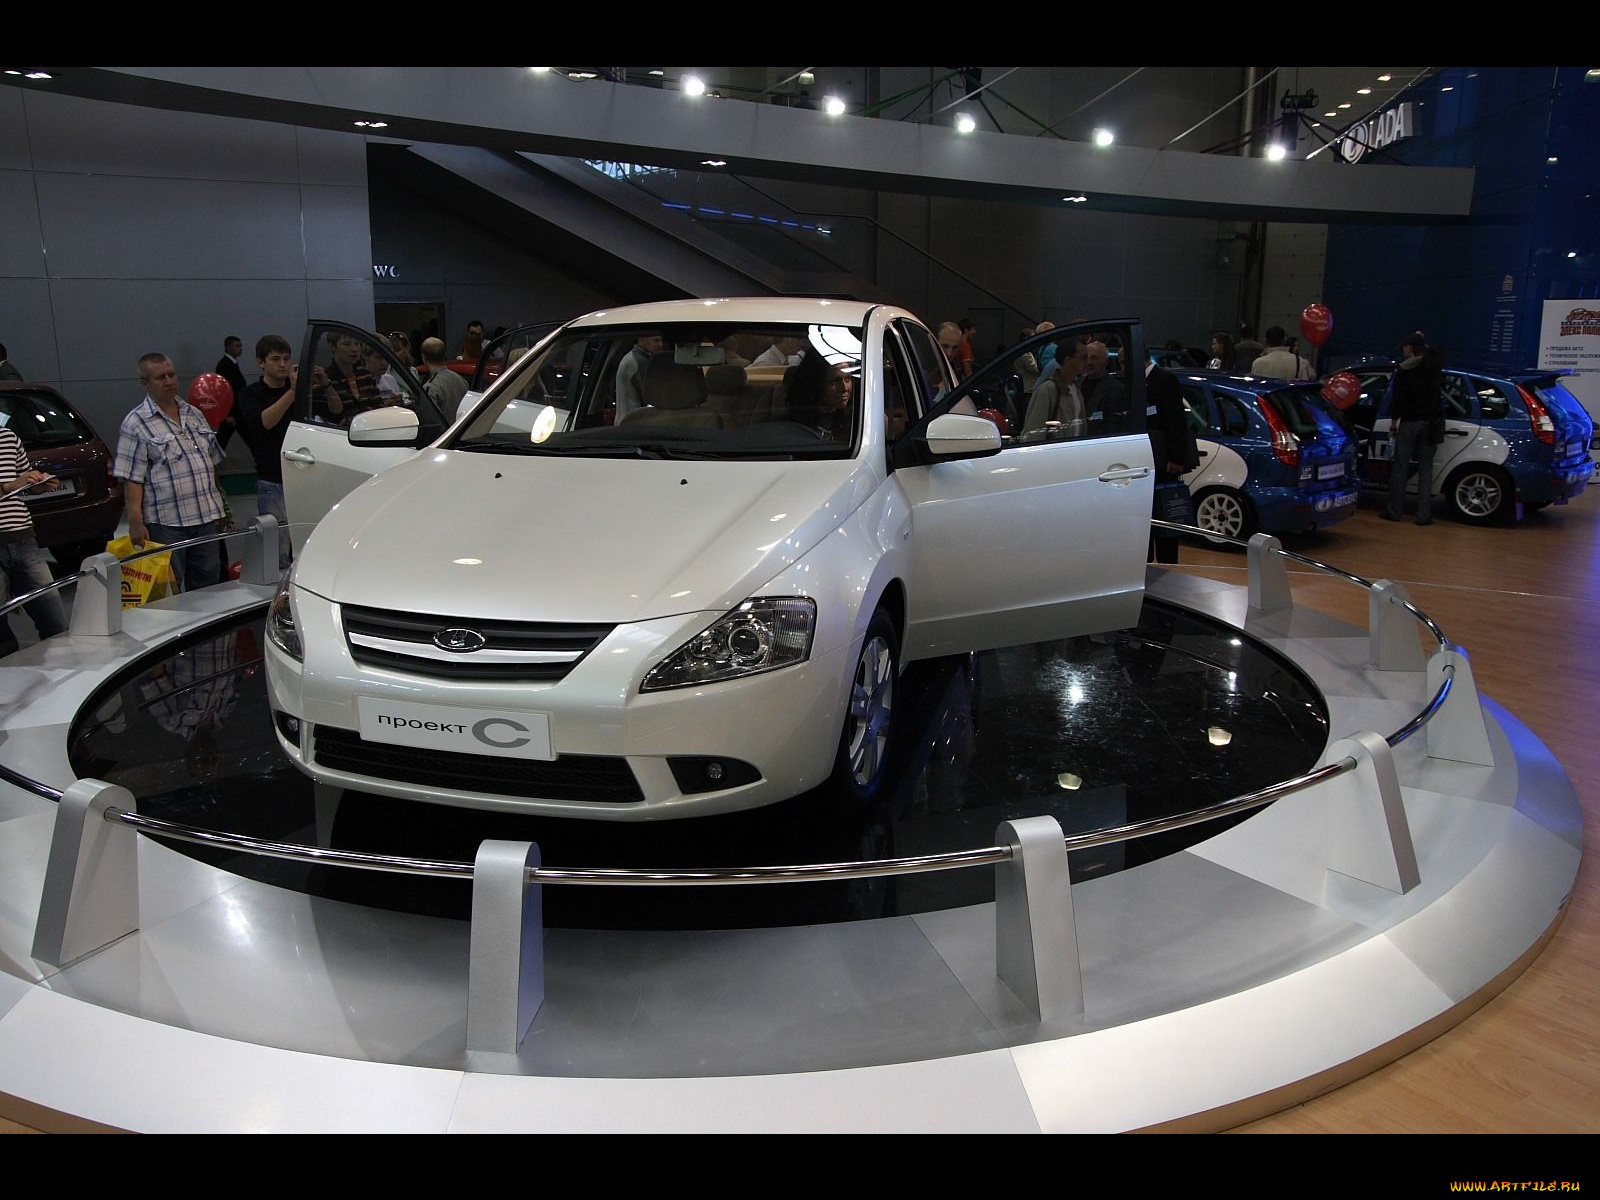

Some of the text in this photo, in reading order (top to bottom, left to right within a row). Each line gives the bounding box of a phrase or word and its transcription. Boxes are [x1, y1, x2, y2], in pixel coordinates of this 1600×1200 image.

[1368, 102, 1411, 153] LADA
[372, 265, 400, 278] WC
[378, 714, 468, 735] проект
